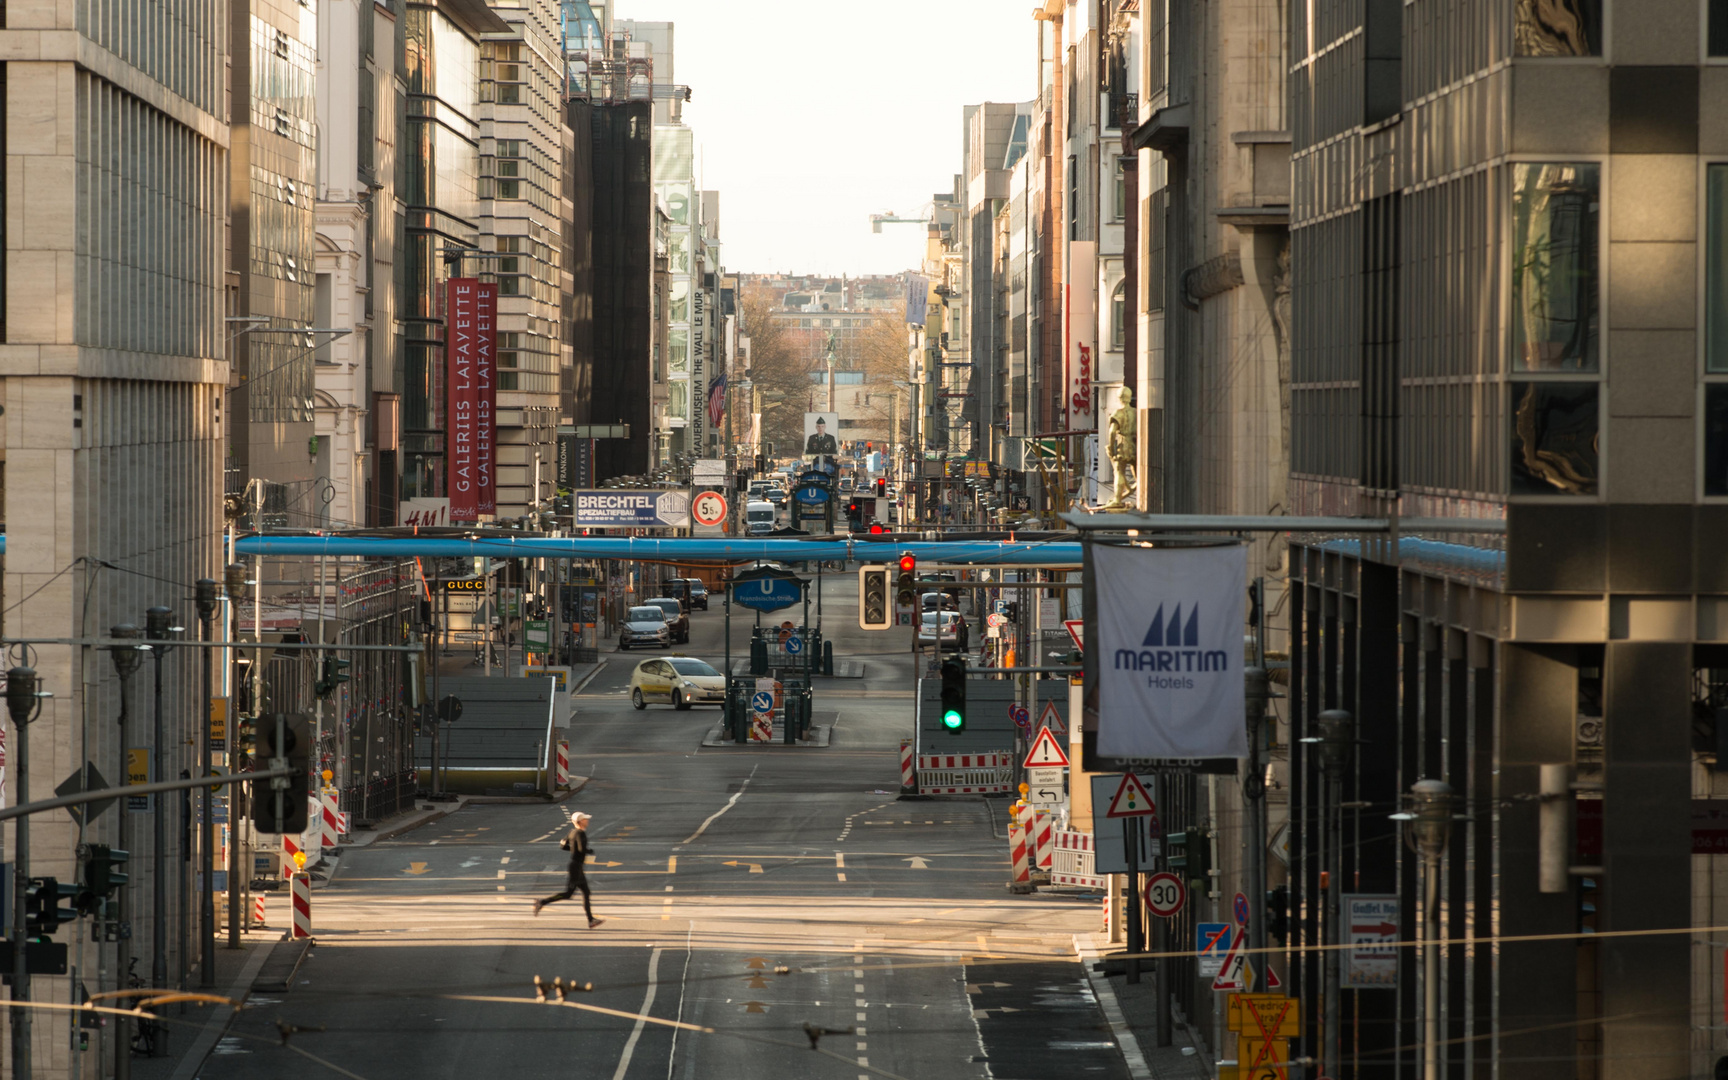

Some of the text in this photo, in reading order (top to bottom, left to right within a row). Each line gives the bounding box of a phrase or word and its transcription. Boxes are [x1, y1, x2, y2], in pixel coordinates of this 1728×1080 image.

[477, 290, 490, 389] LAFAYETTE
[693, 292, 703, 458] MAUERMUSEUM THE WALL LE MUR
[1073, 341, 1090, 416] Leiser
[456, 286, 470, 492] GALERIES LAFAYETTE
[477, 400, 489, 487] GALERIES
[808, 488, 817, 498] U
[577, 495, 654, 509] BRECHTEL
[577, 509, 636, 517] SPEZIALTIEFBAU
[760, 579, 774, 595] U
[996, 601, 1005, 612] P
[1115, 649, 1227, 672] MARITIM
[1148, 676, 1194, 689] Hotels
[1153, 885, 1177, 905] 30
[1246, 1001, 1294, 1011] riedric-
[1257, 1012, 1286, 1023] traße
